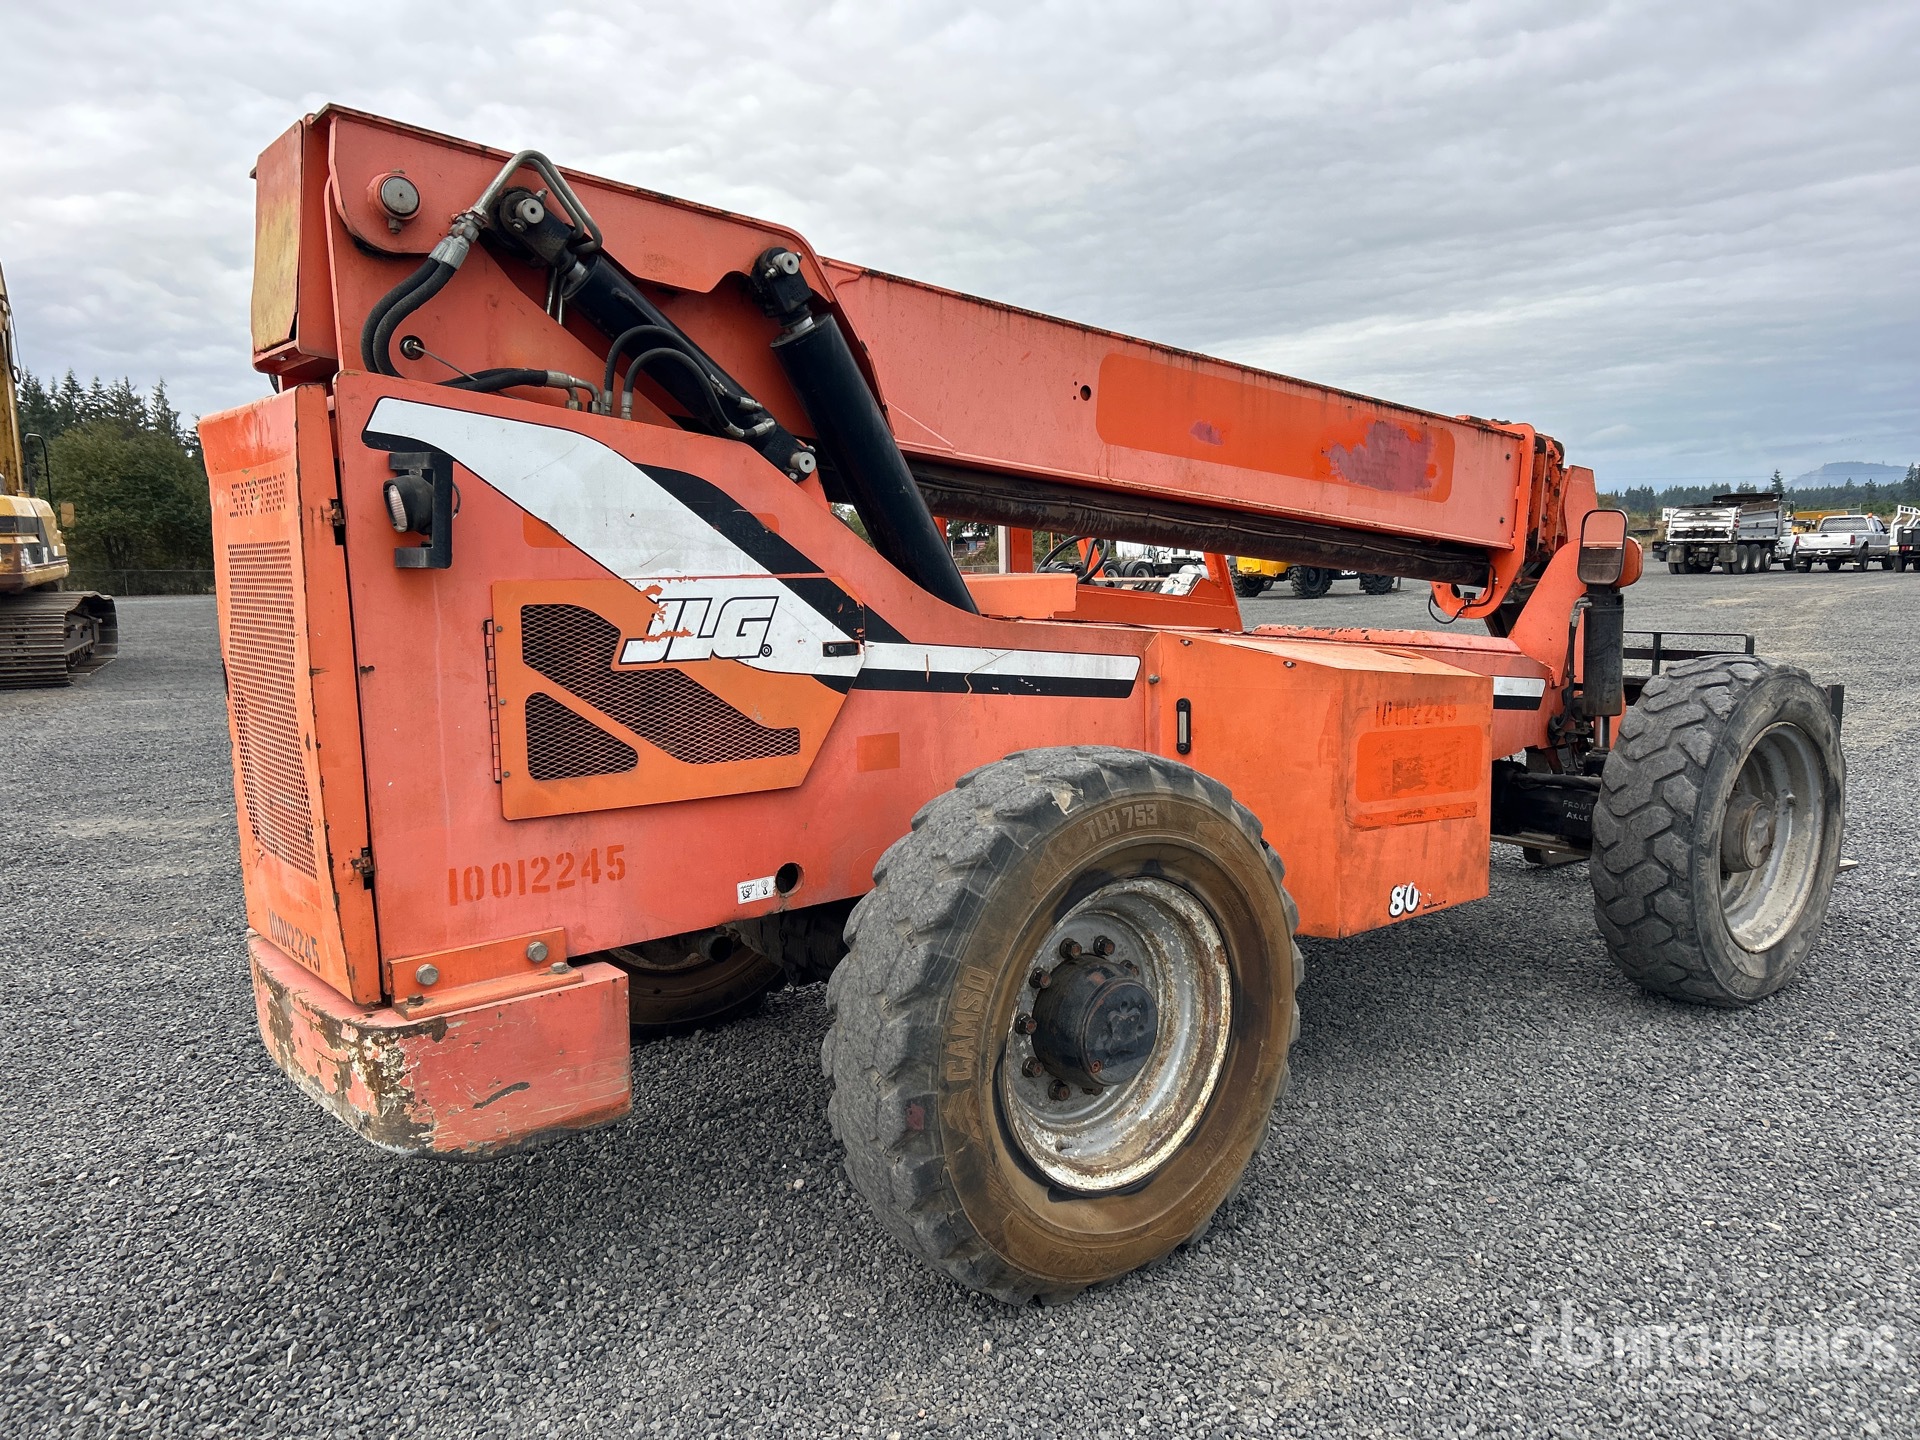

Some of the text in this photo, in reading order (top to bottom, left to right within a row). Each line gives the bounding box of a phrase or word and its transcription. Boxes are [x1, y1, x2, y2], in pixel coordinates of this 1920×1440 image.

[618, 596, 779, 664] JLG
[1083, 803, 1158, 842] TLH 753
[1562, 799, 1594, 811] FRONT
[1566, 811, 1590, 822] AXLE
[448, 844, 626, 907] 10012245
[1388, 881, 1421, 918] 80
[946, 965, 991, 1082] CAMSO
